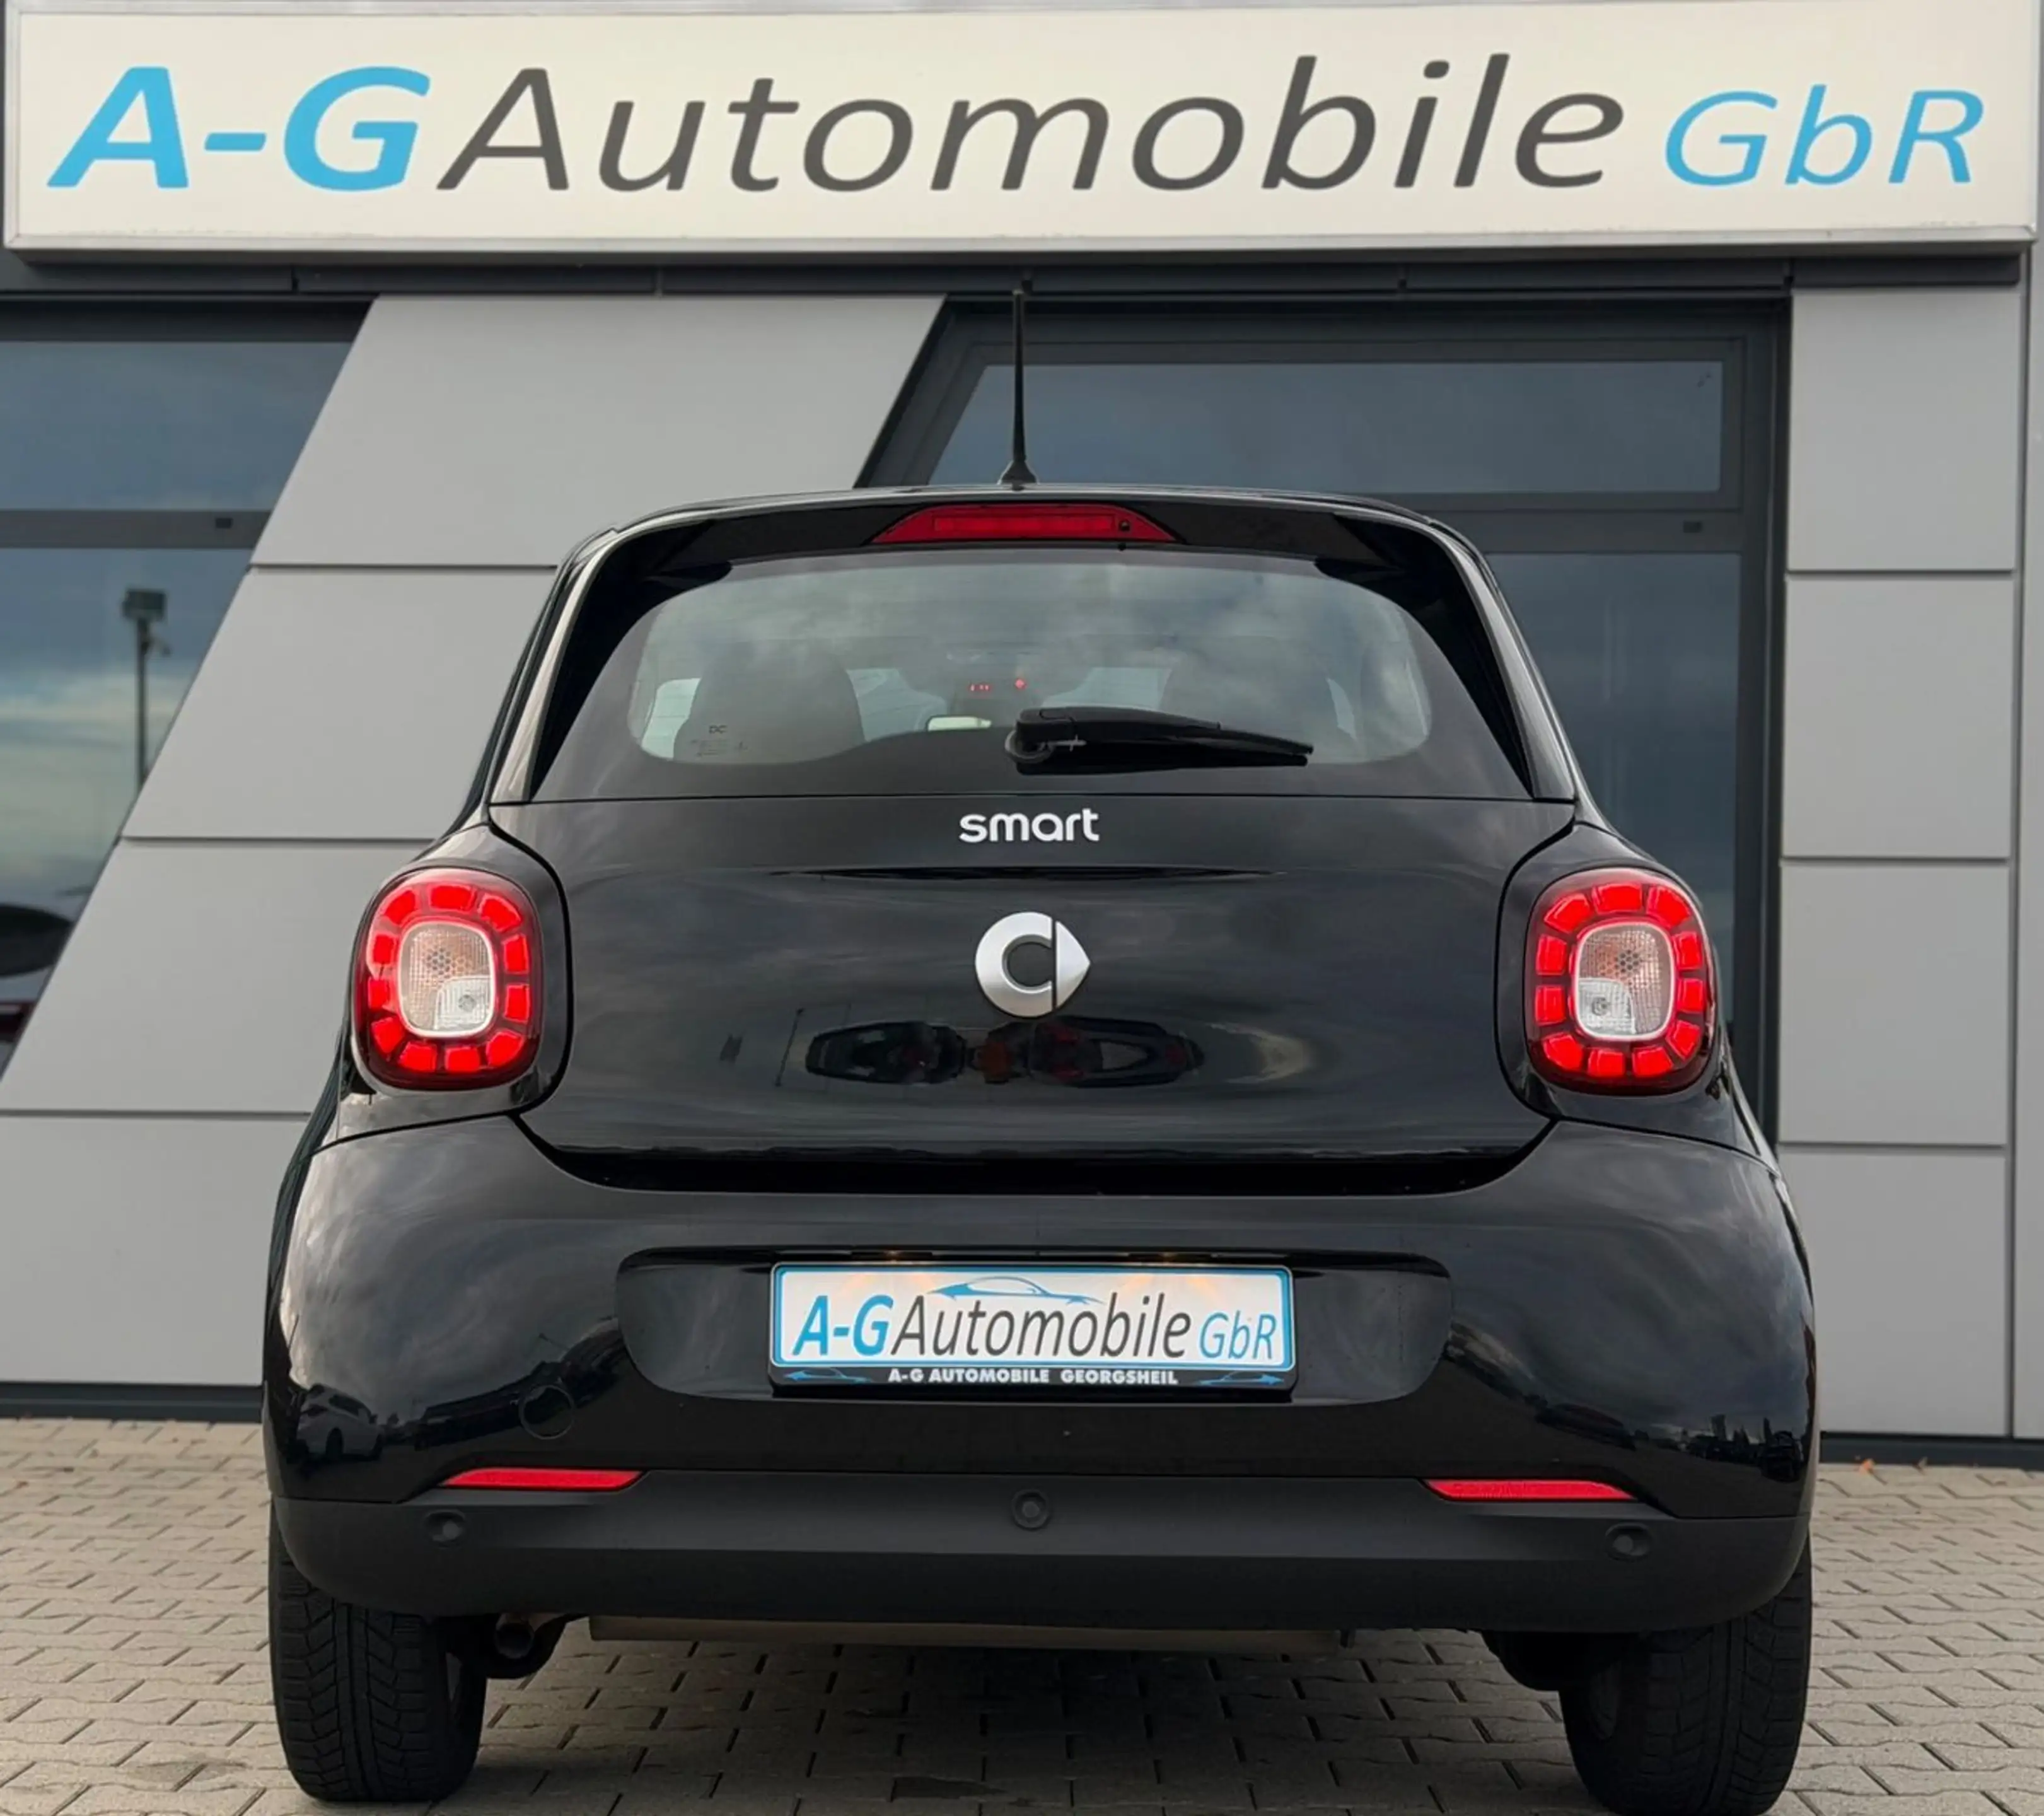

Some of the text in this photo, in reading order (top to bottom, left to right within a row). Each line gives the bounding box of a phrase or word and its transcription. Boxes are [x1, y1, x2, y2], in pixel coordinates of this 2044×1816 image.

[437, 55, 1623, 192] Automobile
[1666, 84, 1983, 187] GbR
[959, 808, 1100, 843] smart
[890, 1292, 1191, 1358] Automobile
[1199, 1310, 1277, 1359] GbR
[888, 1368, 1178, 1385] A-G AUTOMOBILE GEORGSHEIL
